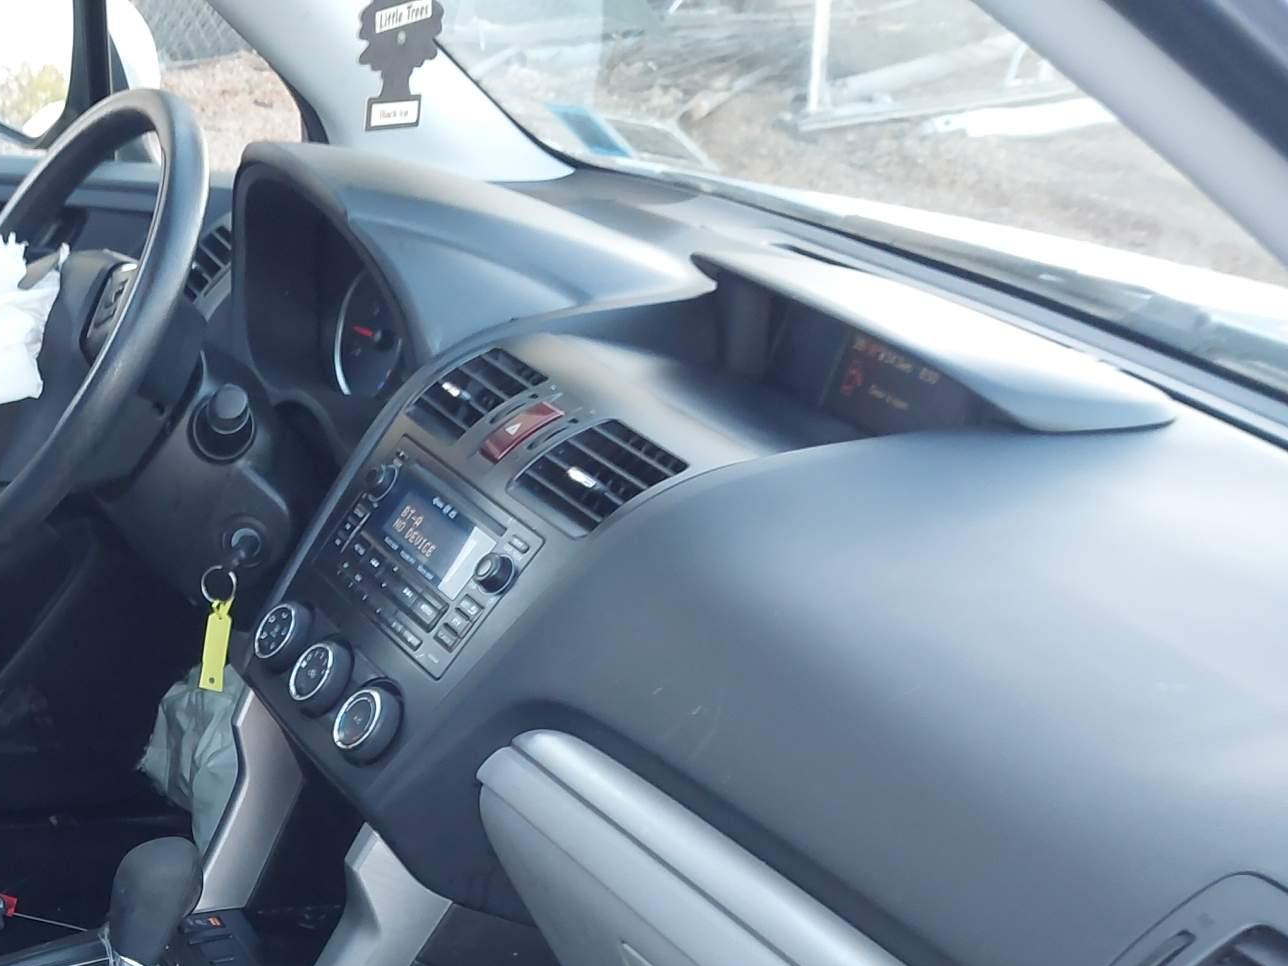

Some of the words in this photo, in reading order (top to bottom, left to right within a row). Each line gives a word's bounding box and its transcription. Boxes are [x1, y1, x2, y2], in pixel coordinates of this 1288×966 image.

[379, 8, 403, 29] Little
[407, 3, 429, 20] Trees
[404, 527, 436, 558] DEVICE
